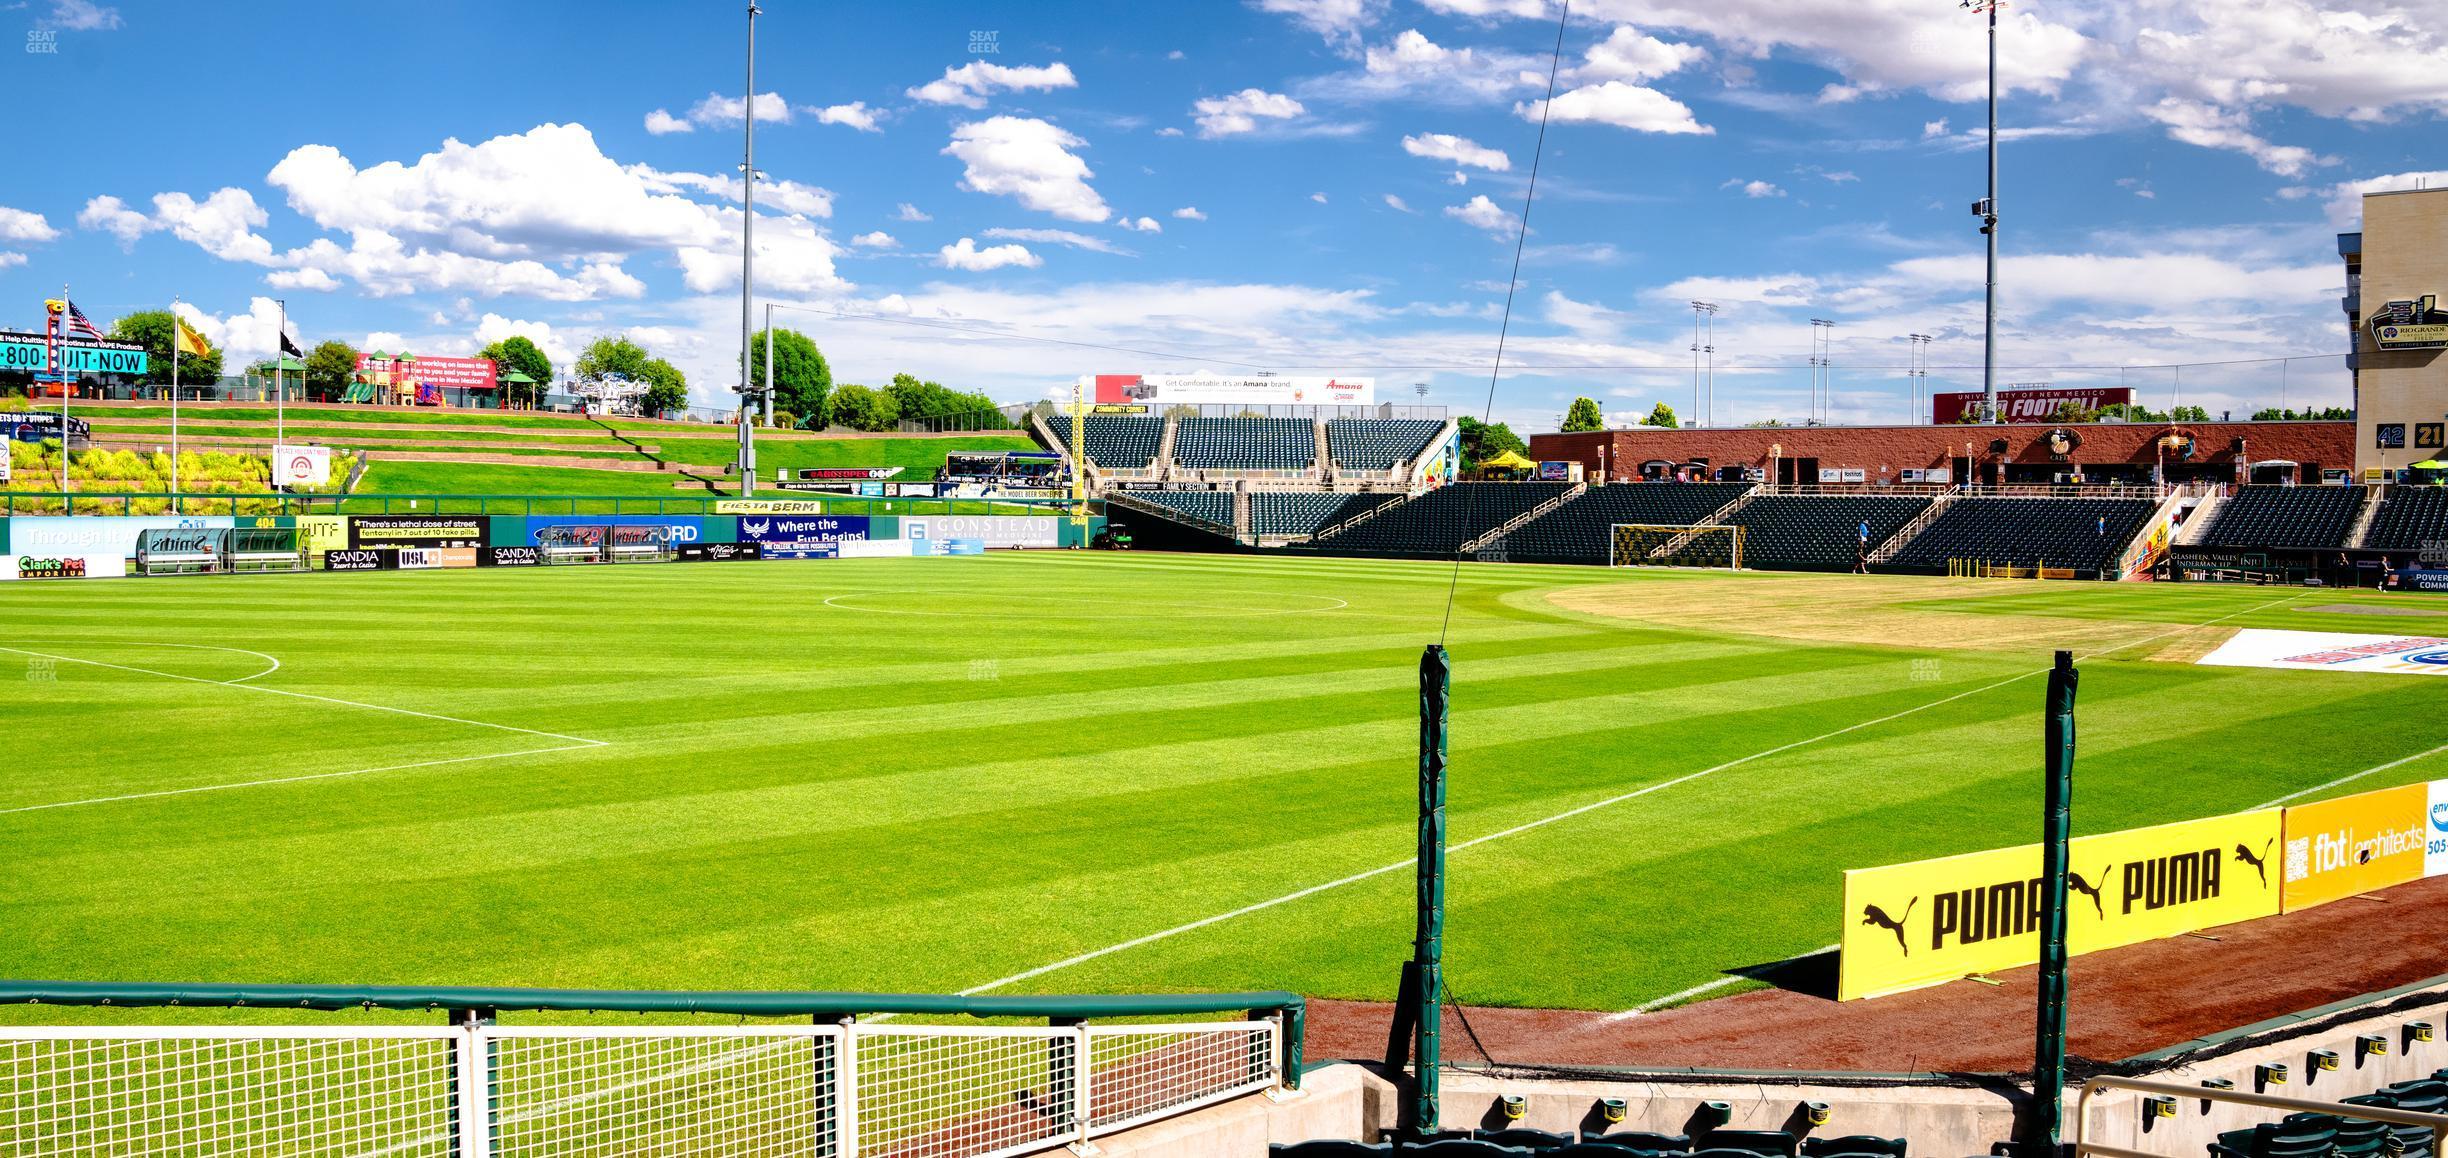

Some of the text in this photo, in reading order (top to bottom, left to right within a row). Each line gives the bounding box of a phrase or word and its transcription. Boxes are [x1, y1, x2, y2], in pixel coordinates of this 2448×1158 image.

[5, 335, 21, 344] Help
[22, 337, 48, 345] Quitting
[116, 343, 143, 351] Products
[1326, 380, 1363, 390] Amana
[2066, 389, 2106, 397] MEXICO
[2378, 426, 2441, 446] 42 21
[771, 502, 816, 512] BERM
[255, 517, 276, 528] 404
[776, 519, 838, 533] Where the
[937, 518, 1050, 532] GONSTEAD
[1070, 517, 1086, 525] 340
[27, 528, 101, 549] Through
[107, 529, 120, 545] It
[362, 529, 395, 537] fentanyl
[460, 529, 477, 537] pills.
[648, 525, 698, 542] FORD
[821, 530, 865, 542] Begins!
[329, 550, 379, 563] SANDIA
[401, 551, 427, 566] USL
[495, 548, 537, 560] SANDIA
[2170, 552, 2211, 562] GLASHEEN,
[19, 555, 85, 571] Clark's Pet
[19, 570, 85, 578] EMPORIUM
[2419, 581, 2448, 589] COMM
[2313, 823, 2424, 874] fbt architects
[2122, 847, 2221, 916] PUMA
[1931, 877, 2042, 952] PUMA
